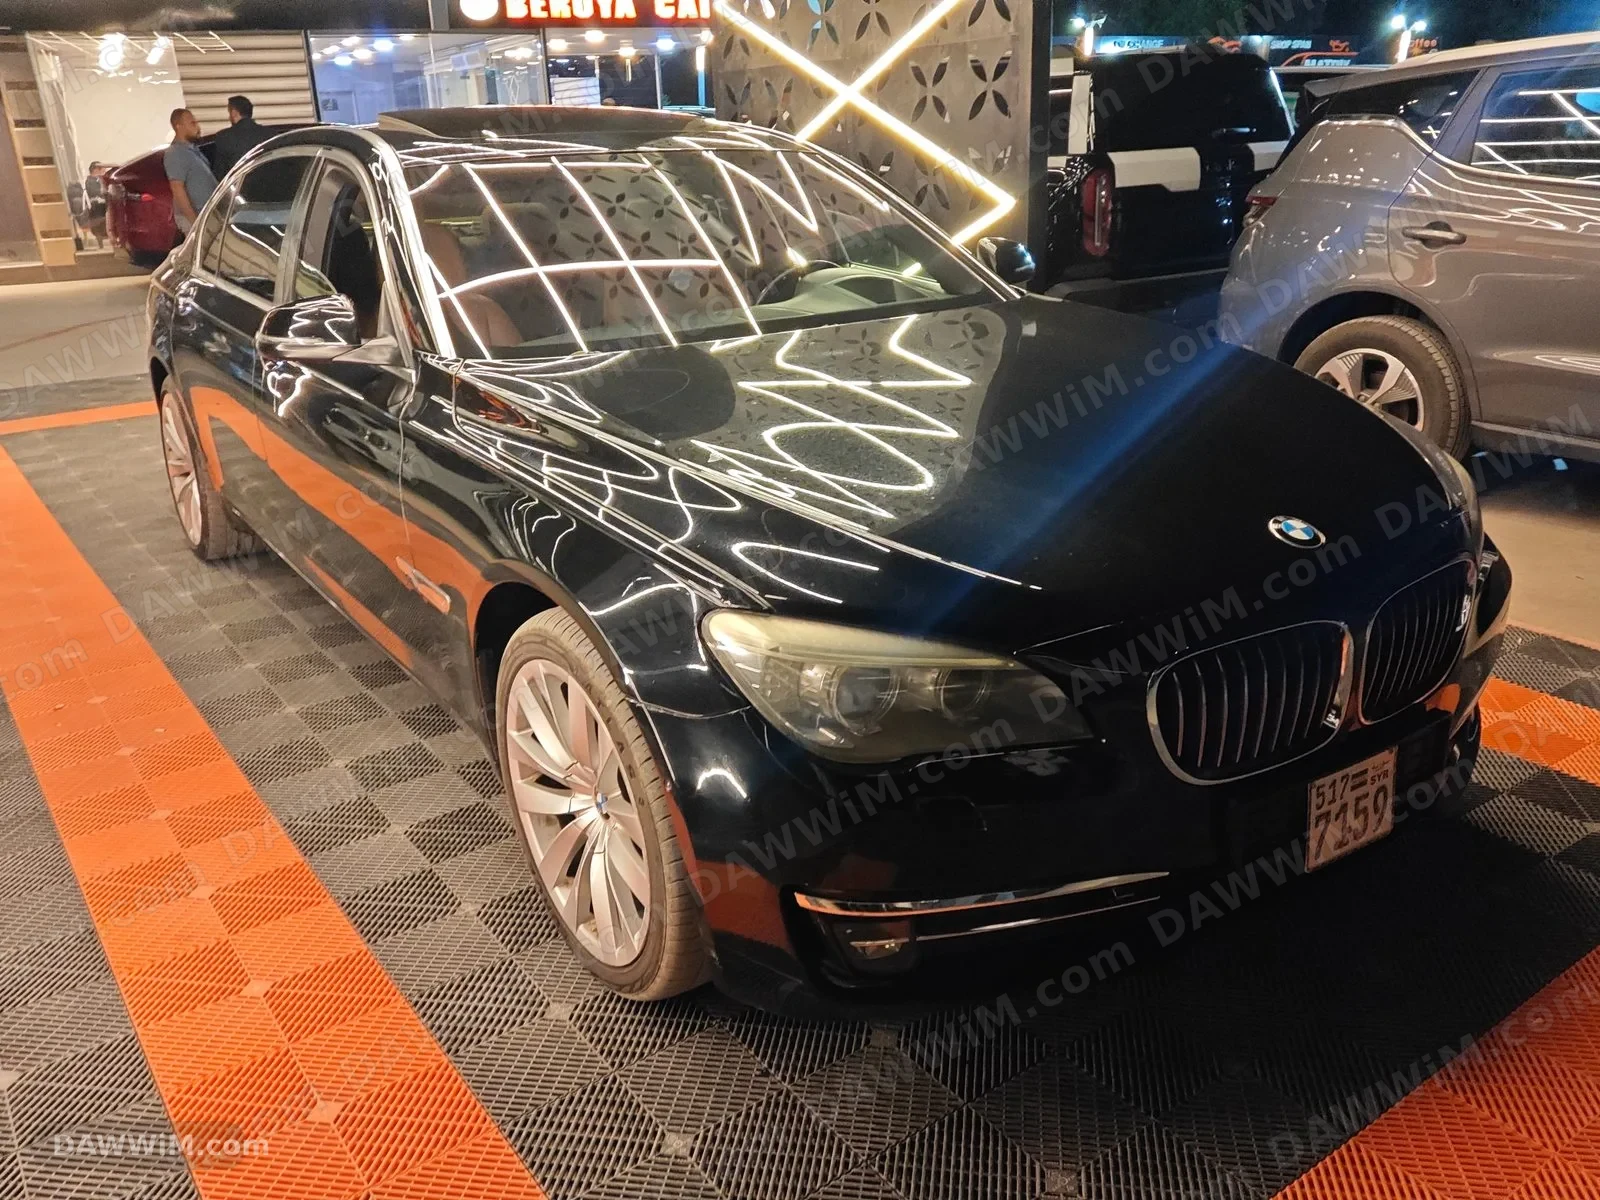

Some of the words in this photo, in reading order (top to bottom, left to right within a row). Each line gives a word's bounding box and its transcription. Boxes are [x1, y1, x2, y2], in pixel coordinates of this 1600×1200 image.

[1315, 773, 1350, 811] 517
[1370, 769, 1389, 786] SYR
[1314, 784, 1388, 861] 7159
